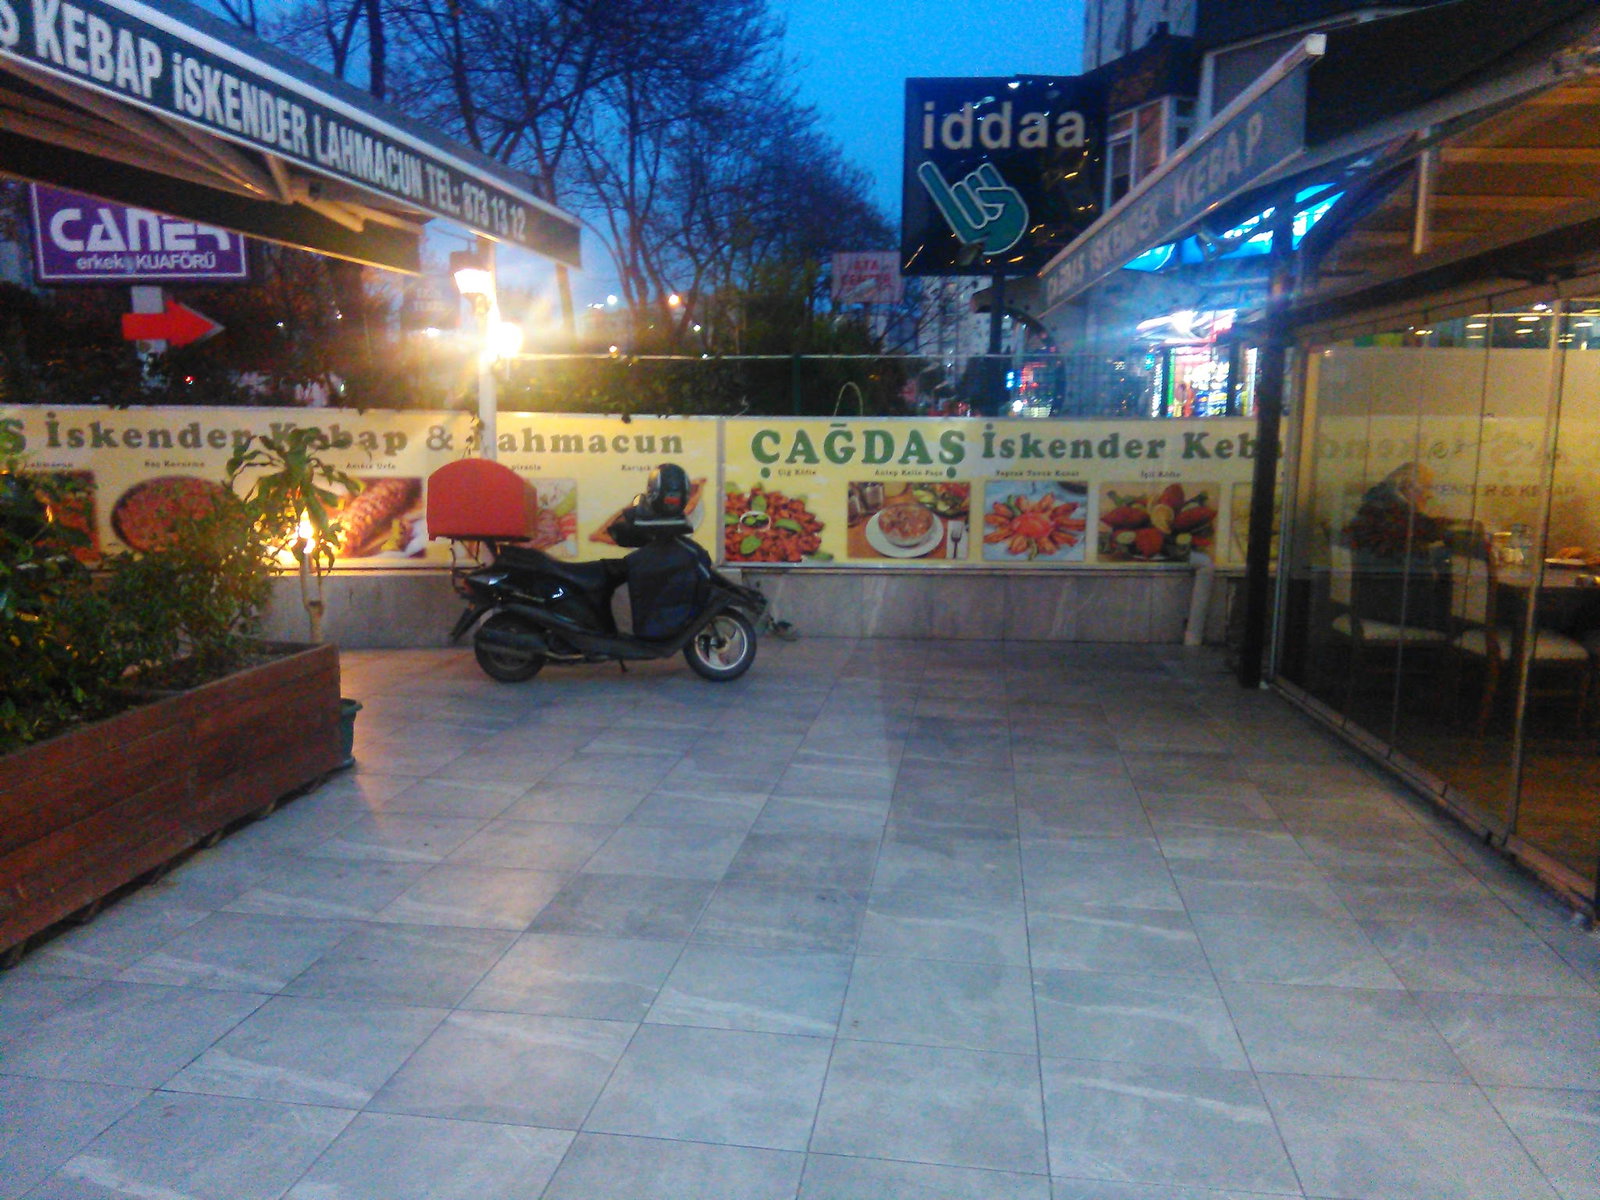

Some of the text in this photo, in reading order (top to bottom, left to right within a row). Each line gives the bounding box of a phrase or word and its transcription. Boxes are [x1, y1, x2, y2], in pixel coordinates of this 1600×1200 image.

[32, 0, 163, 99] KEBAP
[313, 113, 424, 200] LAHMACUN
[923, 100, 1086, 149] iddaa
[75, 251, 216, 270] erkek KUAFÖRÜ
[426, 425, 453, 451] &
[751, 423, 966, 479] ÇAĞDAŞ
[981, 423, 1166, 459] İskender
